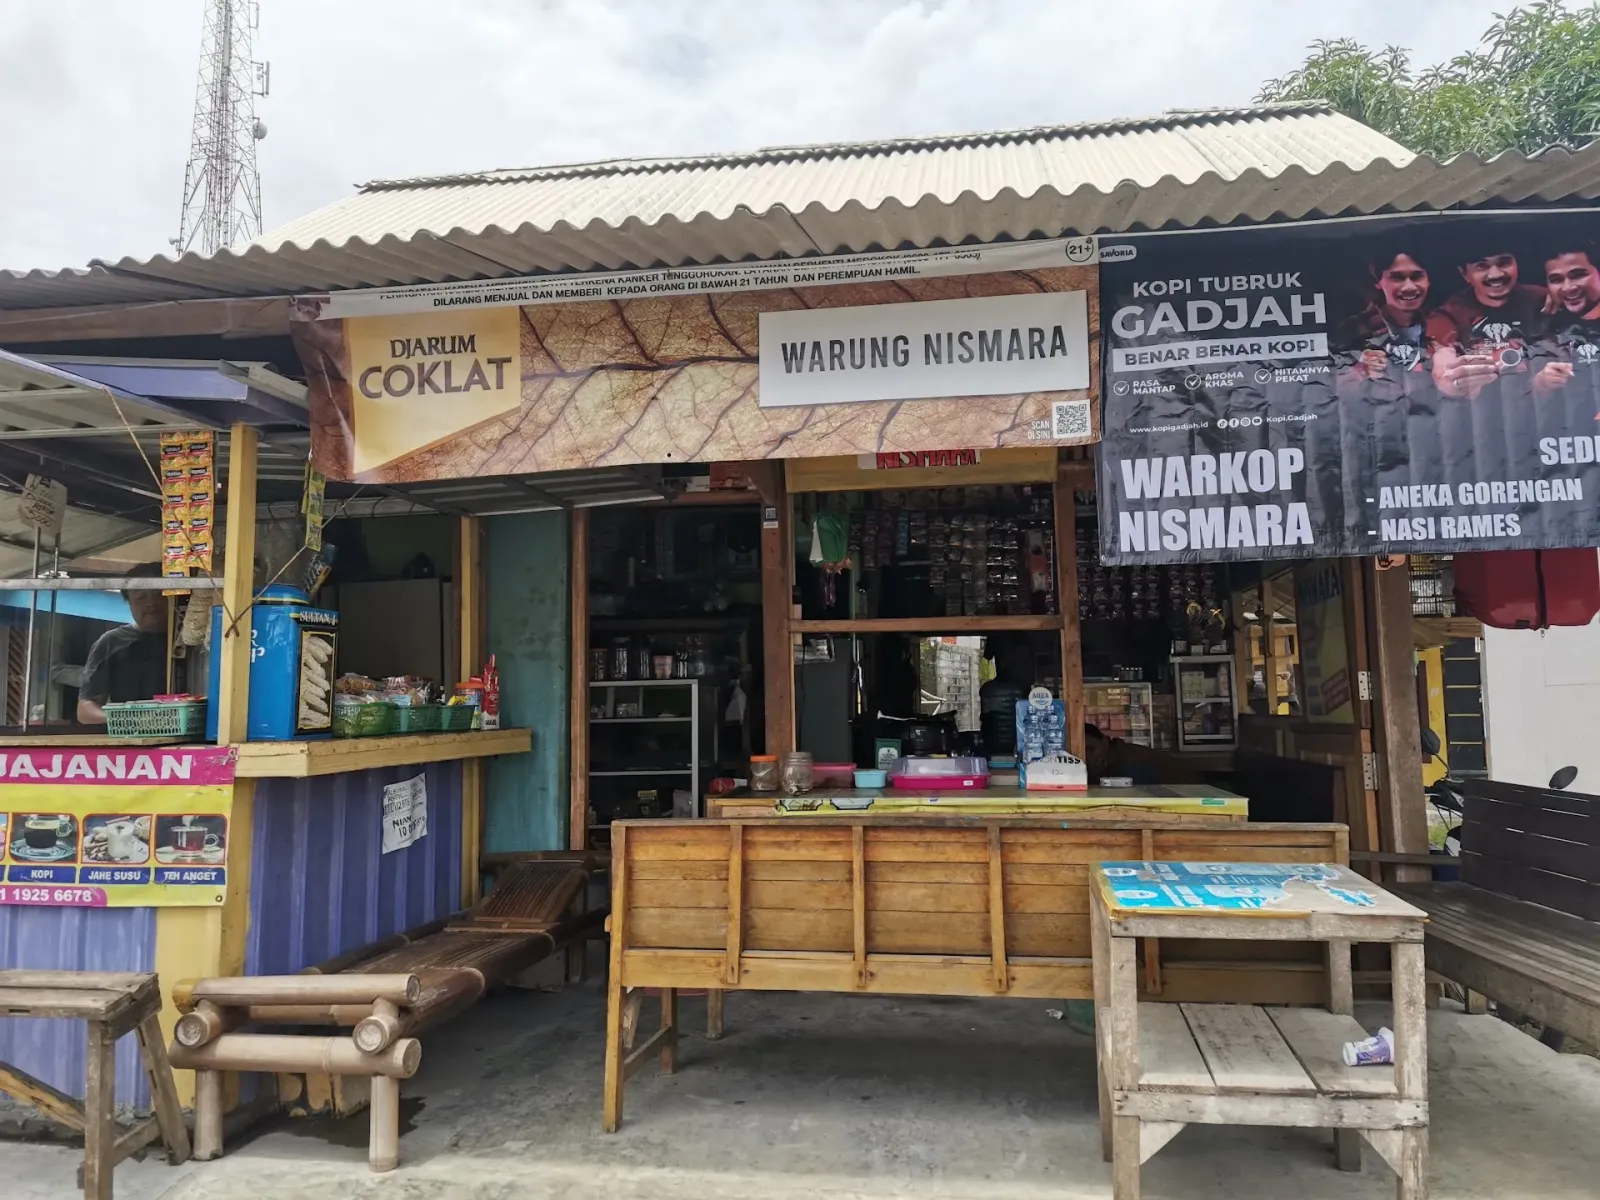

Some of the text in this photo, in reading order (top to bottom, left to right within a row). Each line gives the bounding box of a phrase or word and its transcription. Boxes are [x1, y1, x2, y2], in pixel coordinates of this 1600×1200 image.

[1069, 244, 1092, 255] 21+
[1100, 249, 1134, 259] SAVORIA
[618, 273, 659, 285] KANKER
[434, 265, 920, 307] DILARANG MENJUAL DAN MEMBERI KEPADA ORANG DI BAWAH 21 TAHUN DAN PEREMPUAN HAMIL.
[1133, 272, 1302, 298] KOPI TUBRUK
[1111, 293, 1327, 339] GADJAH
[390, 334, 477, 358] DJARUM
[781, 325, 1068, 375] WARUNG NISMARA
[1125, 339, 1315, 366] BENAR BENAR KOPI
[1205, 371, 1244, 380] AROMA
[1274, 366, 1330, 376] HITAMNYA
[359, 357, 512, 399] COKLAT
[1133, 379, 1160, 388] RASA
[1275, 374, 1309, 383] PEKAT
[1205, 379, 1234, 389] KHAS
[1133, 385, 1176, 395] MANTAP
[1266, 413, 1318, 424] Kopi.Gadjah
[1031, 420, 1050, 429] SCAN
[1129, 421, 1209, 434] www.kopigadjah.id
[1027, 430, 1051, 440] DI SINI
[1121, 448, 1305, 499] WARKOP
[1379, 483, 1454, 509] ANEKA
[1458, 477, 1583, 504] GORENGAN
[1119, 502, 1315, 552] NISMARA
[1381, 517, 1437, 542] NASI
[1440, 513, 1522, 538] RAMES
[1031, 691, 1049, 699] AQUA
[30, 869, 53, 879] KOPI
[88, 870, 141, 881] JAHE SUSU
[163, 872, 217, 881] TEH ANGET
[13, 888, 49, 902] 1925
[53, 889, 93, 902] 6678
